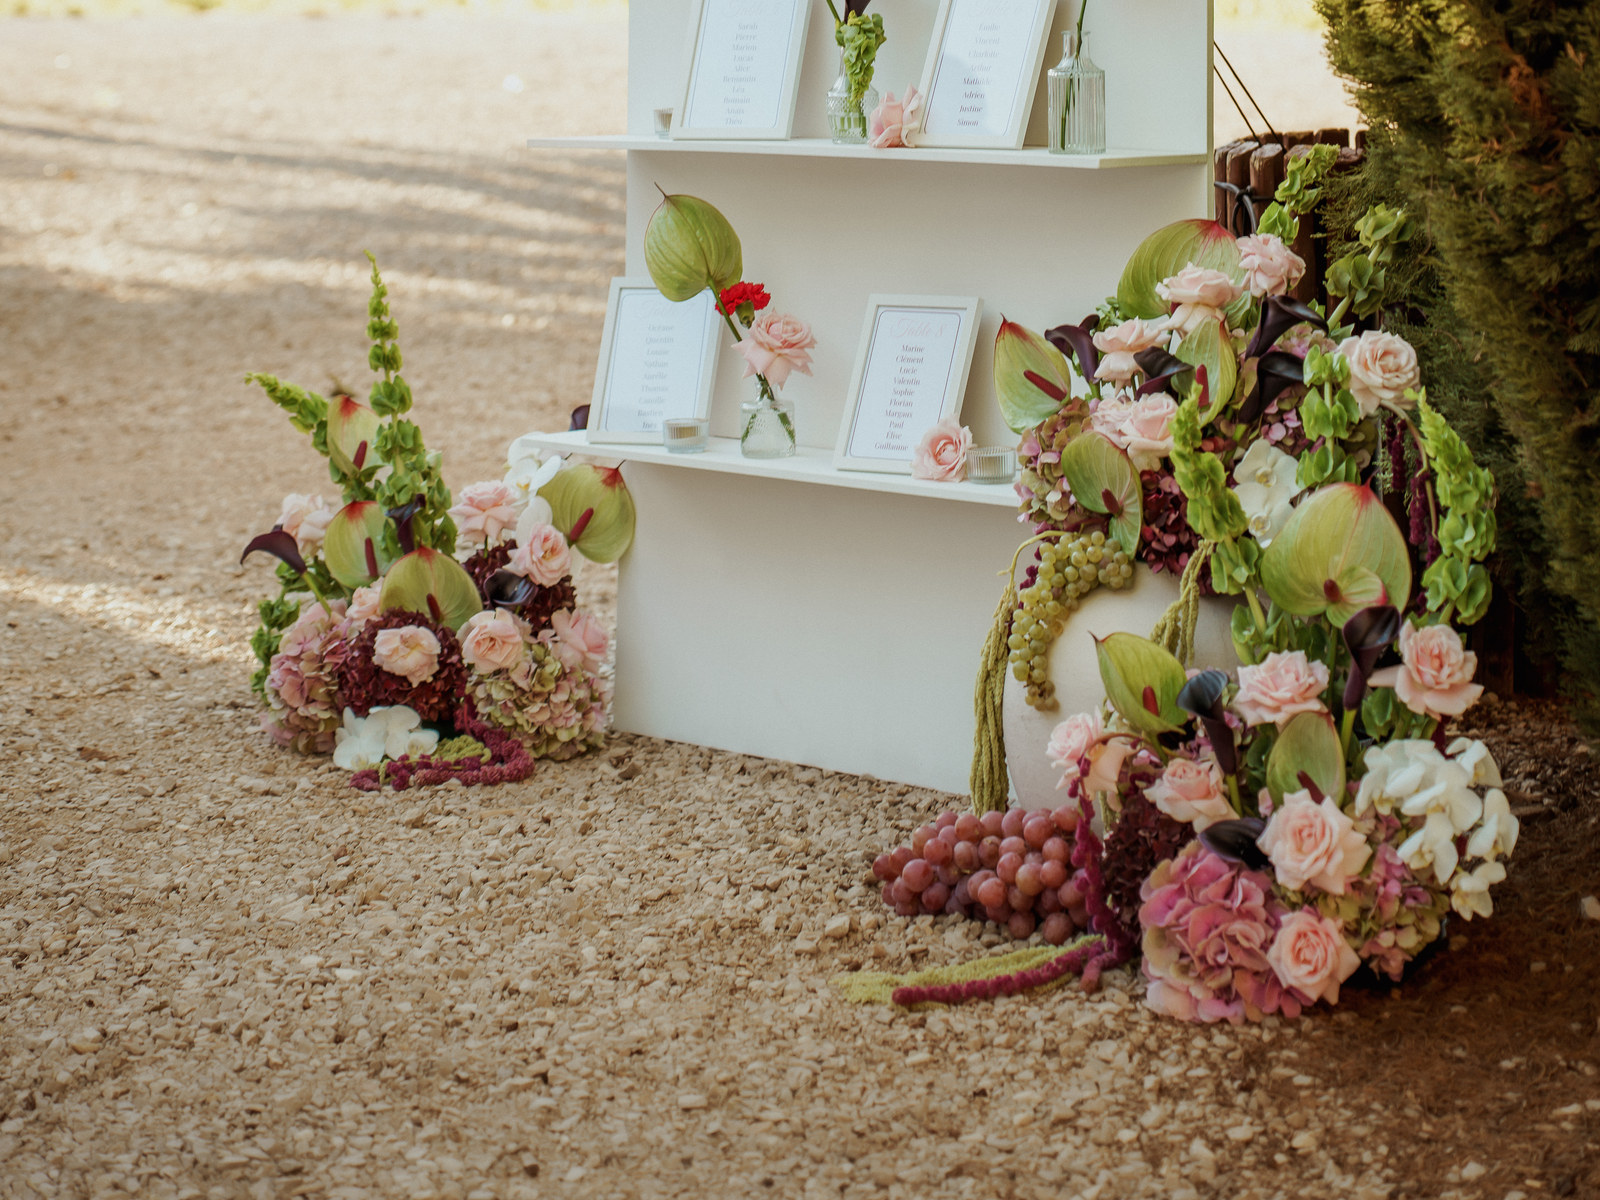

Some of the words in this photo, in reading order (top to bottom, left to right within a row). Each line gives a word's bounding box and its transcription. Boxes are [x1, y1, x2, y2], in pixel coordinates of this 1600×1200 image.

[738, 23, 759, 31] Sarah
[975, 37, 1001, 45] Vincent
[733, 55, 754, 63] Lucas
[968, 50, 1000, 59] Charlotte
[970, 64, 993, 72] Arthur
[962, 91, 986, 100] Adrien
[959, 105, 983, 113] Justine
[957, 119, 979, 127] Simon
[646, 336, 675, 345] Quentin
[902, 344, 925, 353] Marine
[895, 355, 924, 364] Clément
[899, 366, 918, 375] Lucie
[893, 377, 921, 386] Valentin
[892, 388, 916, 397] Sophie
[889, 399, 914, 408] Florian
[637, 409, 664, 417] Bastien
[885, 409, 913, 419] Margaux
[889, 421, 904, 429] Paul
[874, 442, 909, 452] Guillaume
